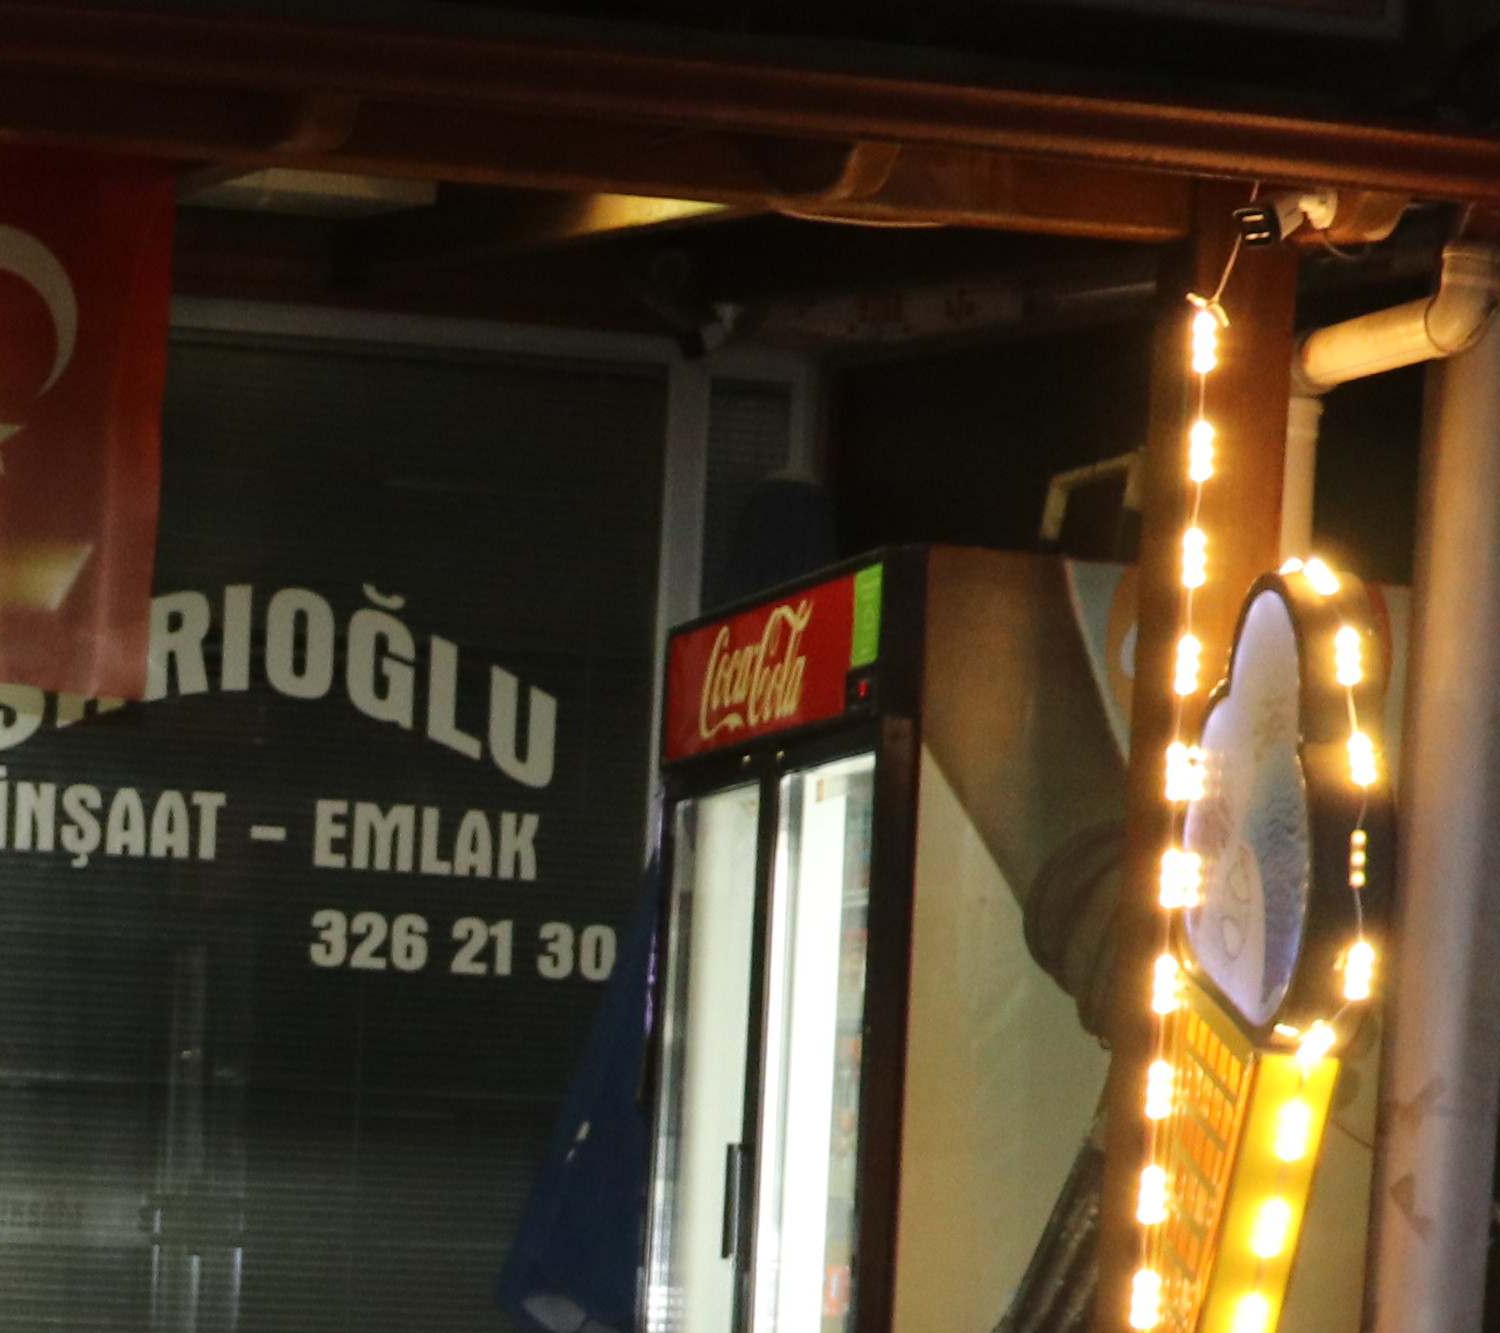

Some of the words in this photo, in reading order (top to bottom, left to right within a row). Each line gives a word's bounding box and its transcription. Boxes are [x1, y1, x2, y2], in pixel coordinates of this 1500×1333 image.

[698, 598, 814, 741] Coca-Cola
[313, 798, 540, 882] EMLAK
[309, 908, 429, 971] 326
[449, 917, 513, 976] 21
[536, 923, 617, 982] 30
